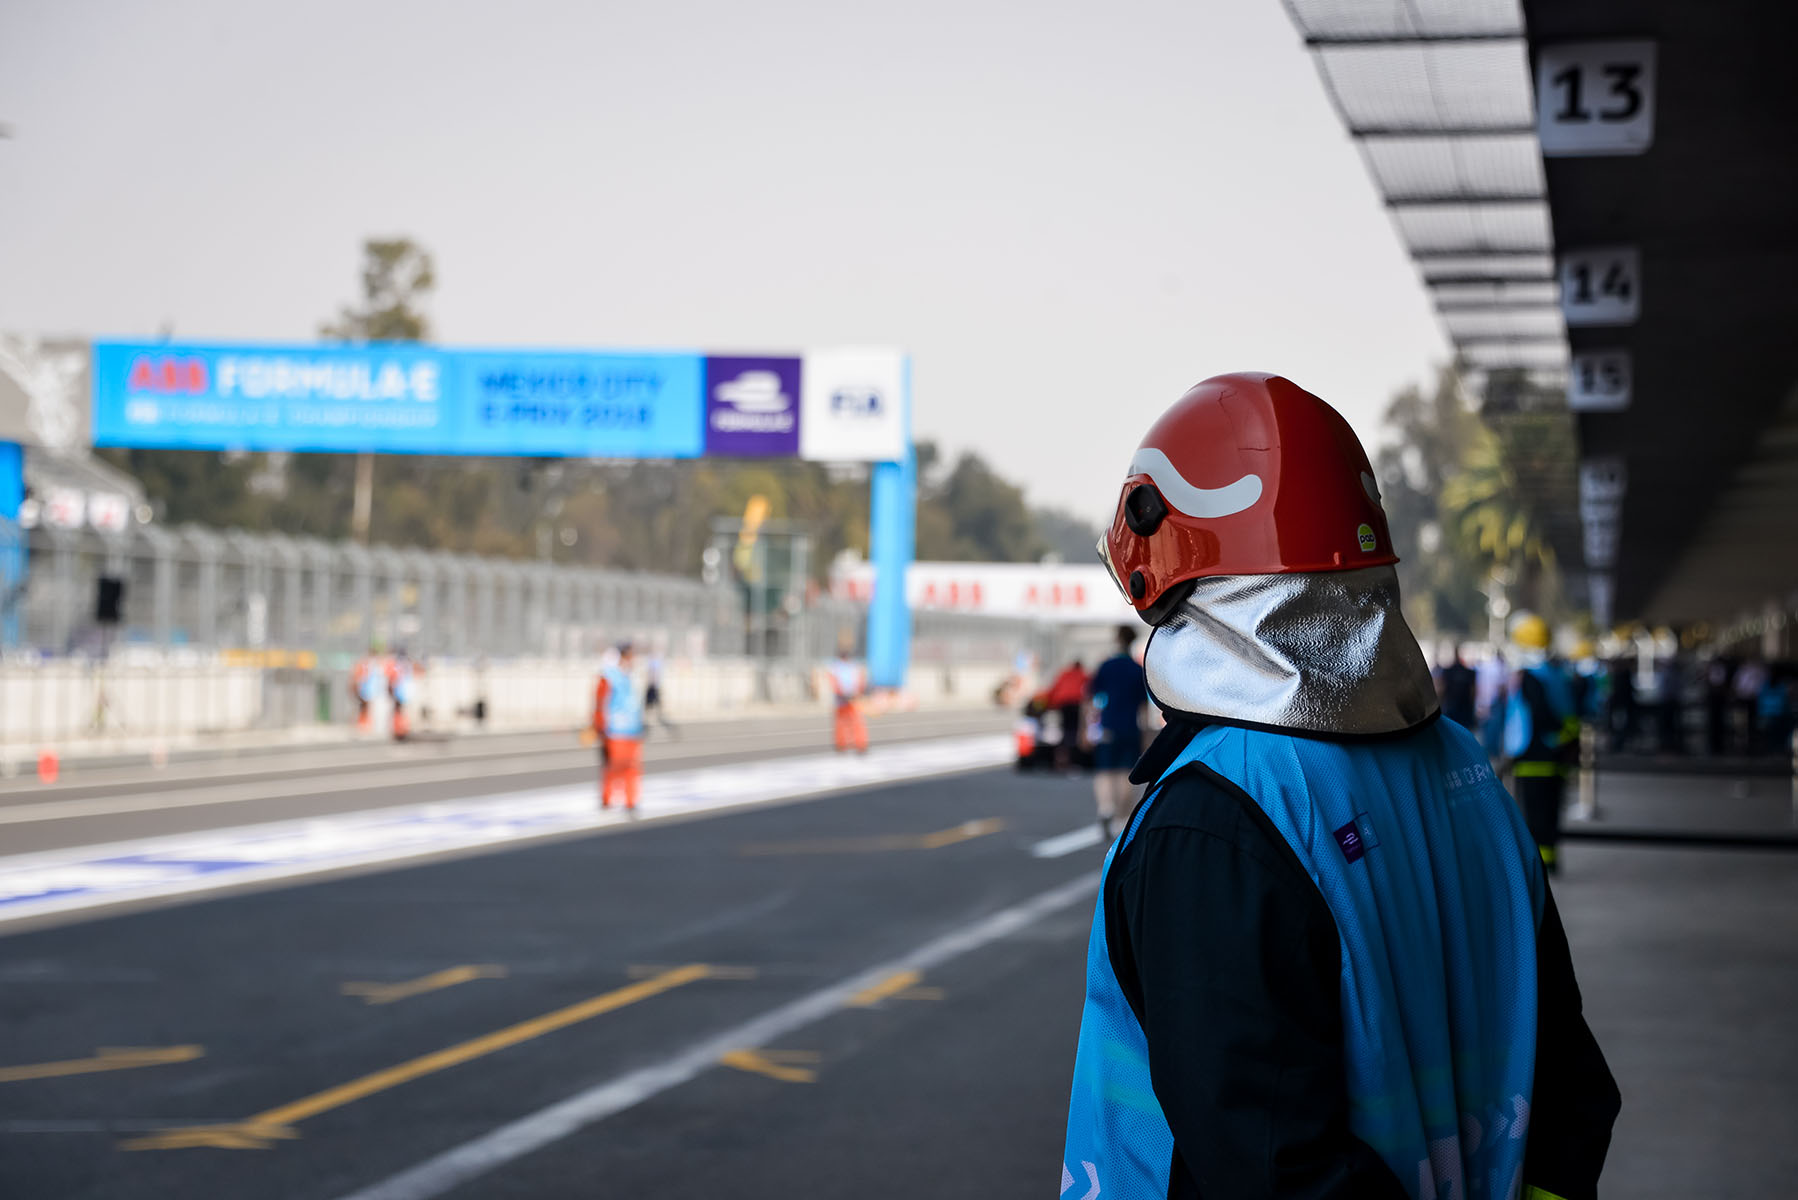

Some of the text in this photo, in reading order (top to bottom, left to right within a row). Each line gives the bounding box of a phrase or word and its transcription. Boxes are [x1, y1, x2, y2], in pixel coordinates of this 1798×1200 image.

[1552, 64, 1642, 123] 13
[1573, 261, 1631, 305] 14
[130, 357, 208, 394] ABB
[1581, 361, 1624, 396] 15
[923, 581, 985, 606] ABB
[1024, 582, 1088, 606] ABB
